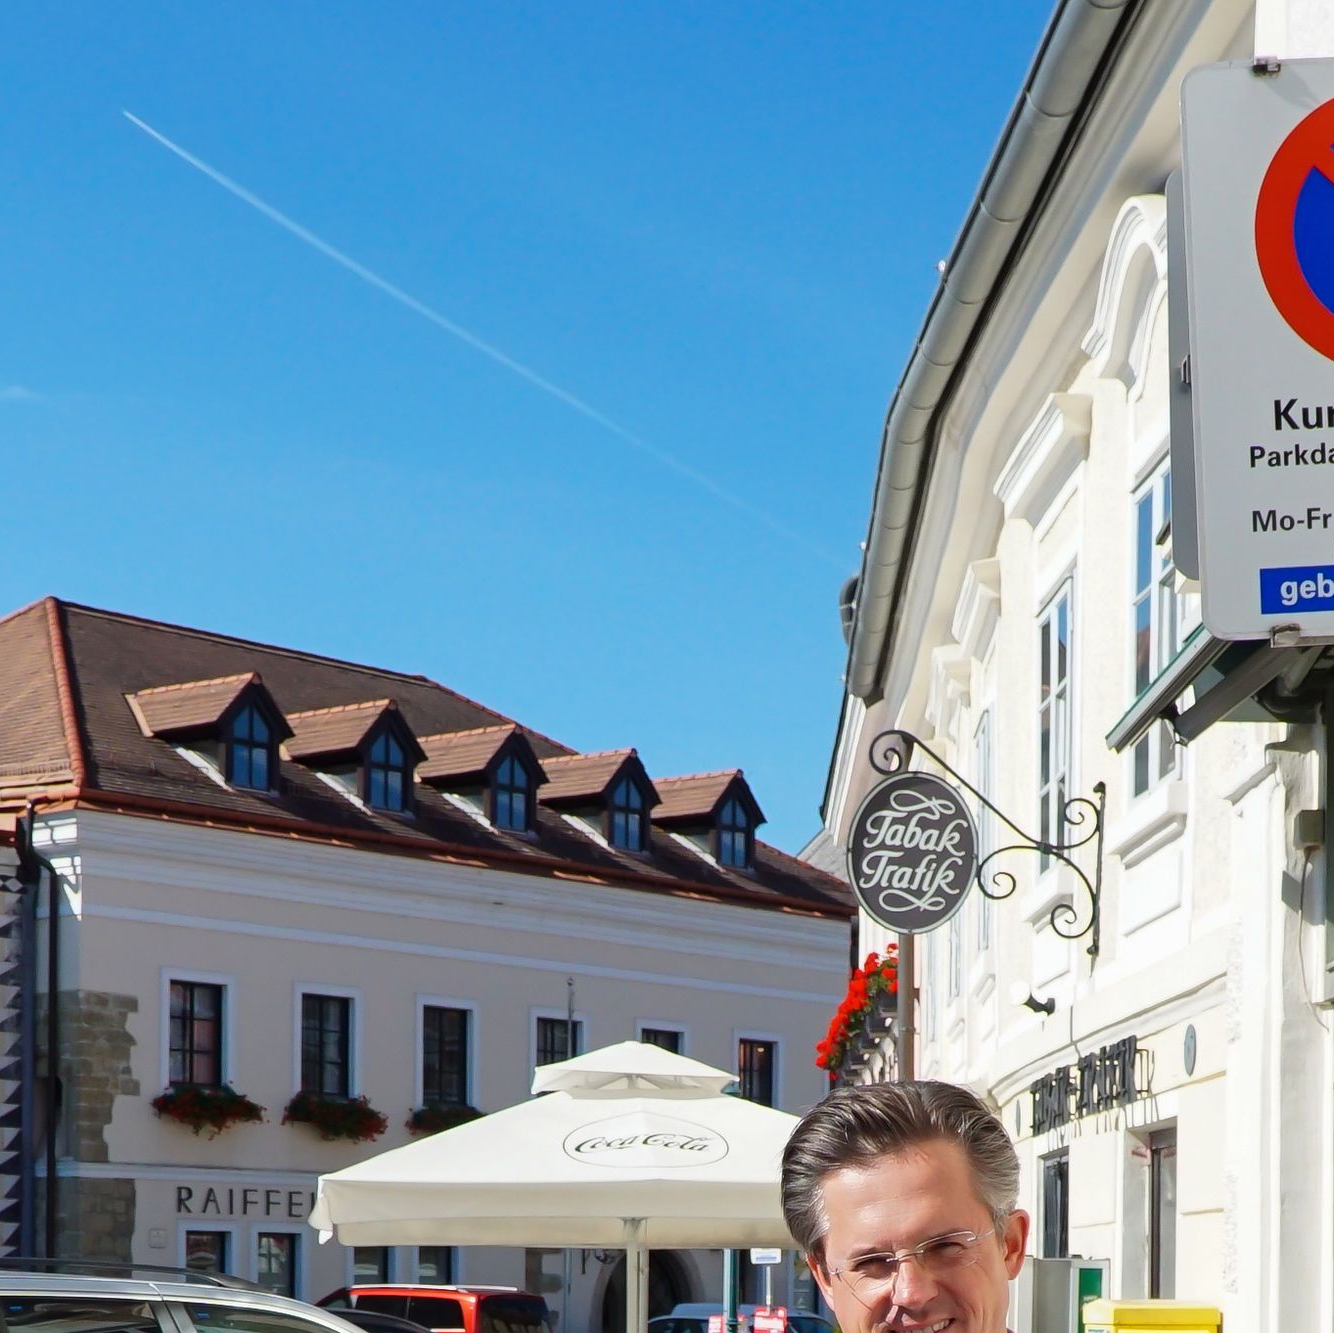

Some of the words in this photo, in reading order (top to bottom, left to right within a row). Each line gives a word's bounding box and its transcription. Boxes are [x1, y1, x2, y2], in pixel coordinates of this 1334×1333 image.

[1251, 507, 1333, 533] Mo-Fr
[863, 806, 968, 857] Tabak
[859, 850, 964, 895] Trafik
